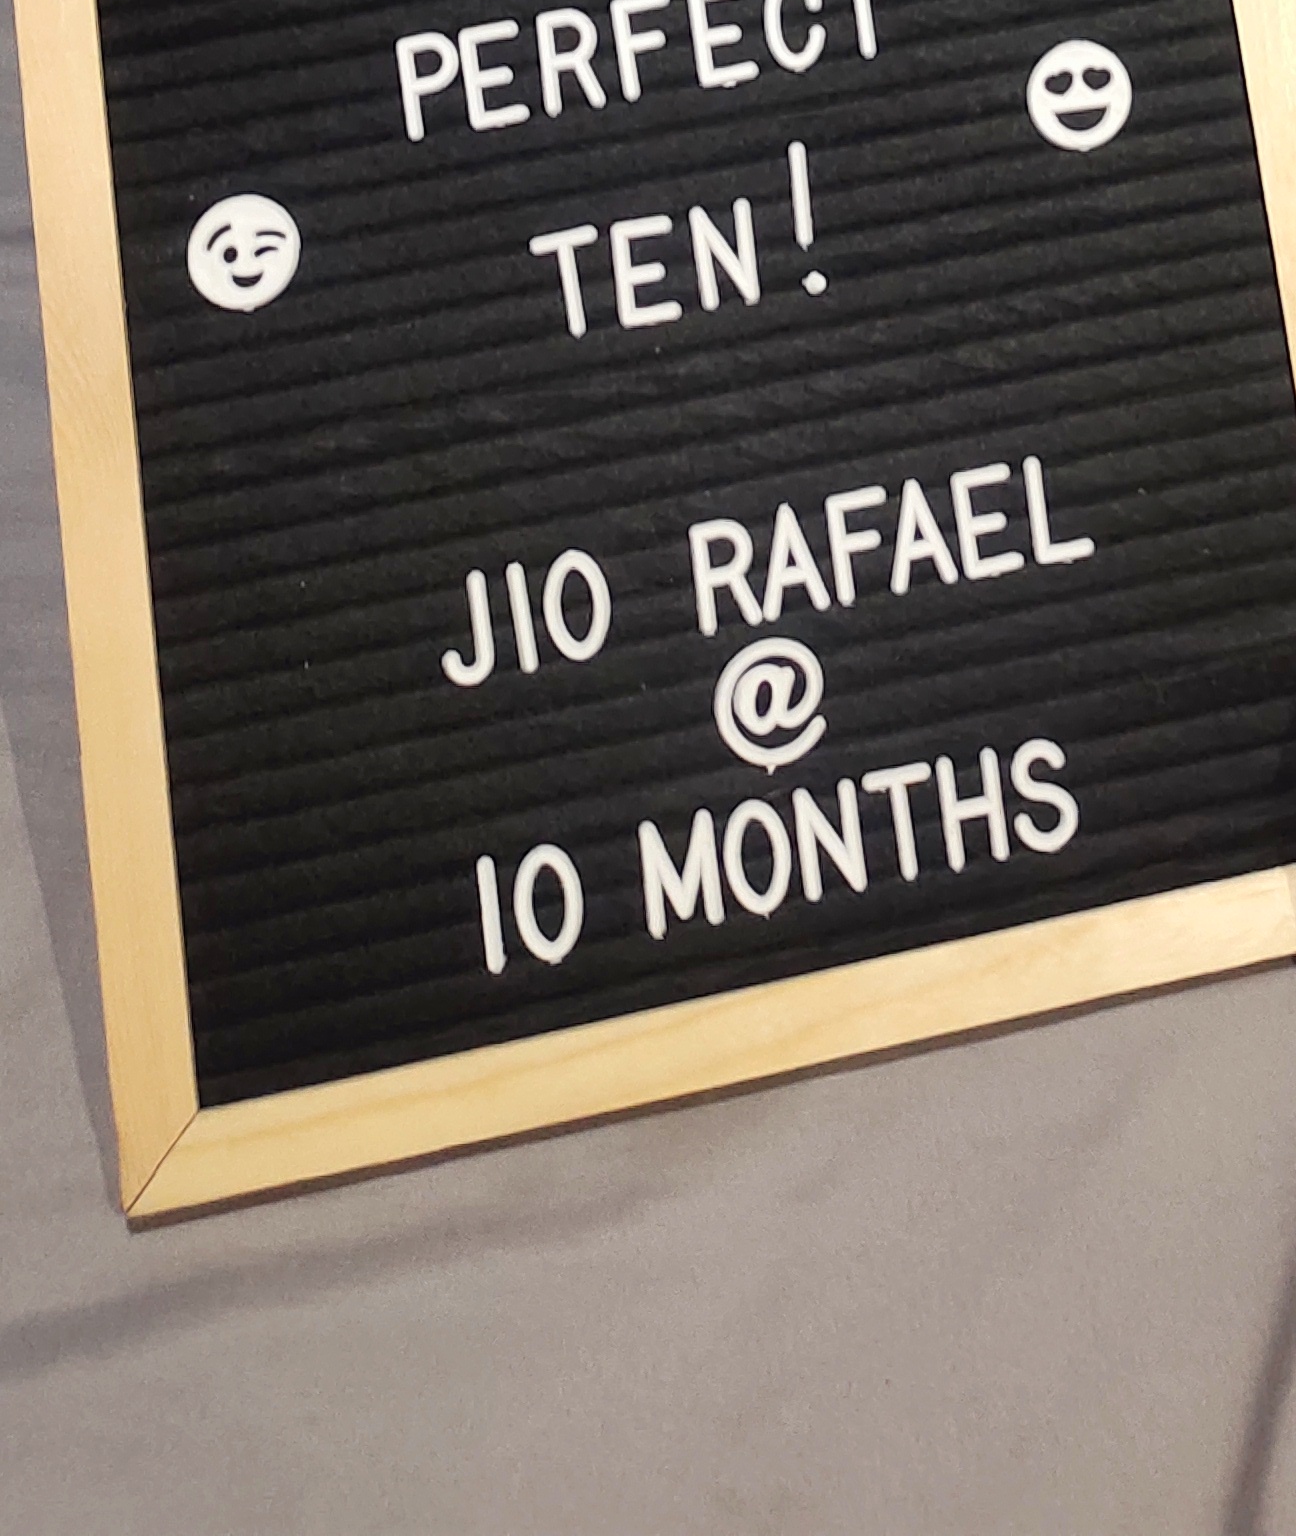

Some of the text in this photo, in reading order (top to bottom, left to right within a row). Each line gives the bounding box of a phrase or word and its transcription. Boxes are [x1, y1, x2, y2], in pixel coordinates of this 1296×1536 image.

[441, 456, 1095, 686] JIO RAFAEL
[714, 637, 827, 775] @
[476, 739, 1079, 974] 10 MONTHS
